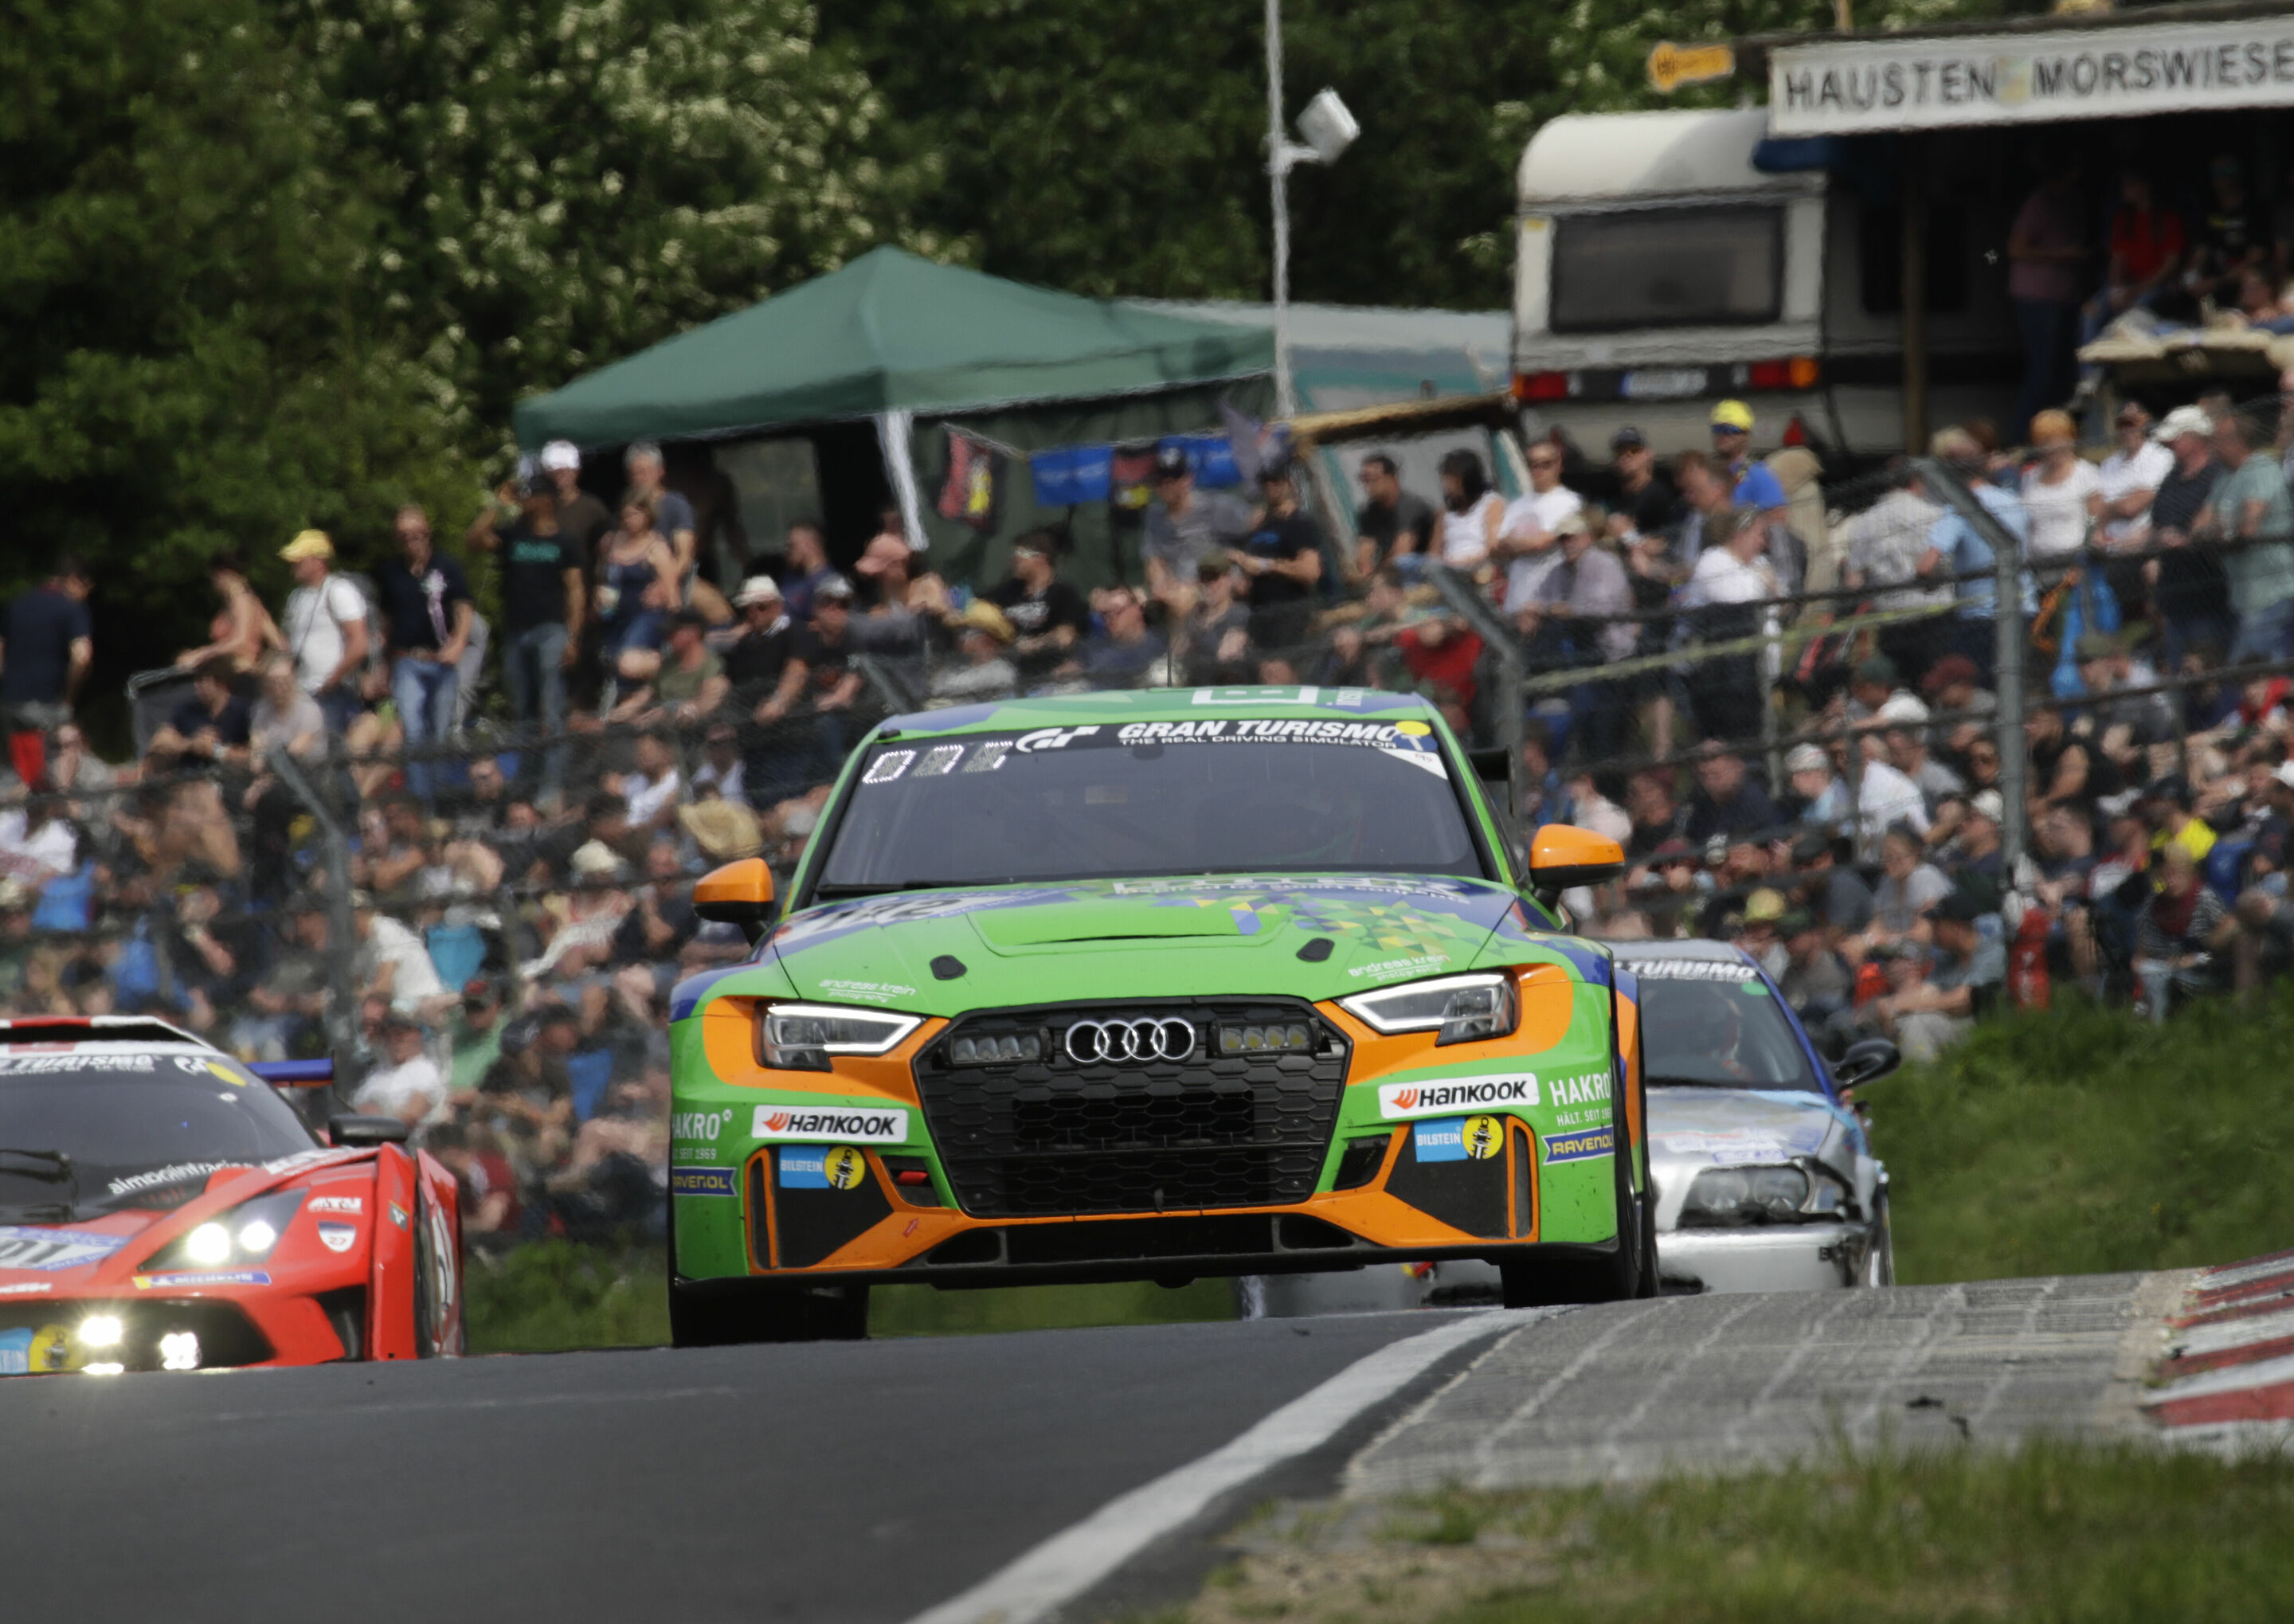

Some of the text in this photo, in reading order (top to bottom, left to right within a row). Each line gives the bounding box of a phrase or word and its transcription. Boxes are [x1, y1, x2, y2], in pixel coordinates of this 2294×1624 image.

[1785, 59, 1998, 111] HAUSTEN
[2033, 40, 2294, 100] MORSWIESE
[1118, 720, 1227, 739] GRAN
[1235, 720, 1402, 742] TURISMO
[1120, 737, 1156, 745] THE
[1161, 735, 1207, 744] REAL
[1292, 736, 1396, 749] SIMULATOR
[1548, 1072, 1611, 1107] HAKRO
[1584, 1109, 1600, 1121] SEIT
[1417, 1133, 1461, 1145] BILSTEIN
[781, 1160, 823, 1172] BILSTEIN
